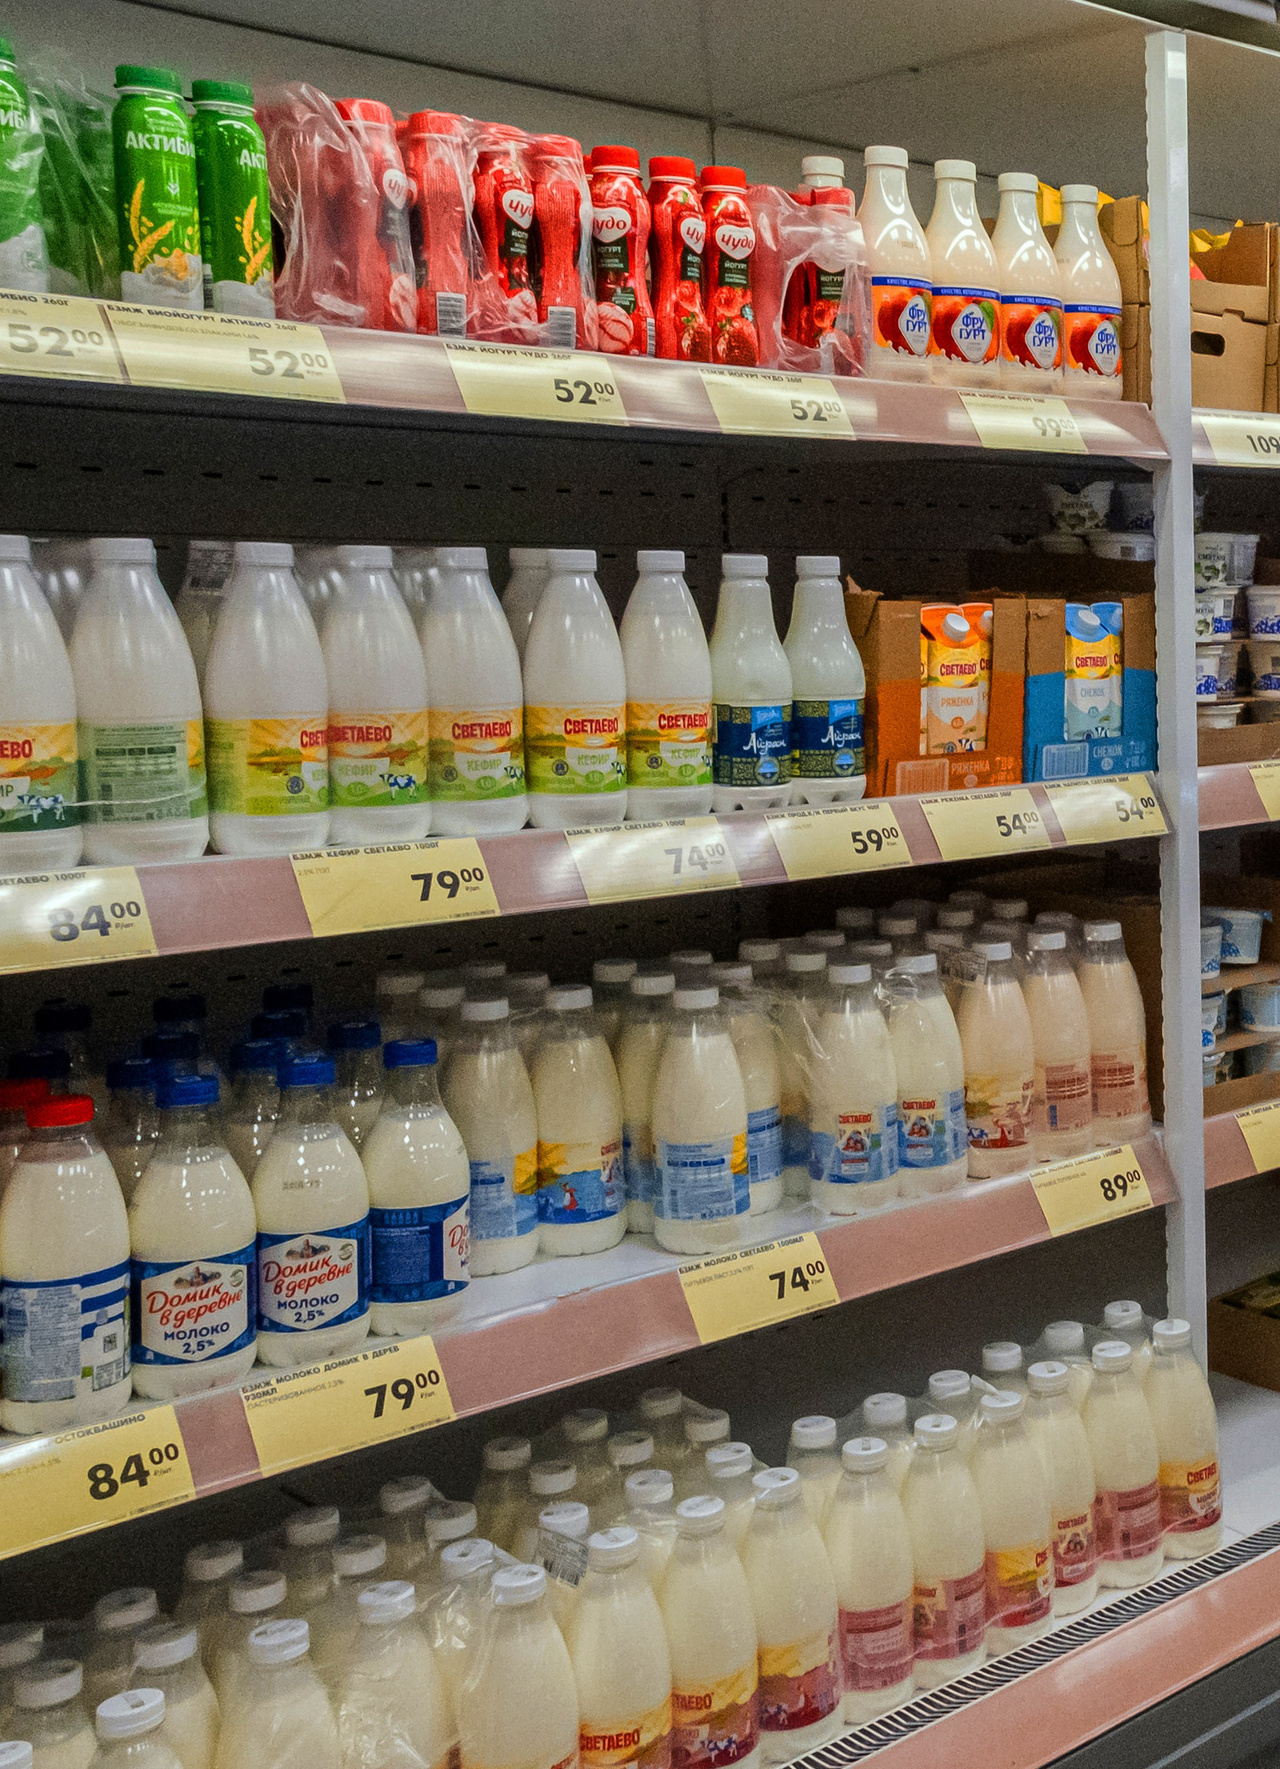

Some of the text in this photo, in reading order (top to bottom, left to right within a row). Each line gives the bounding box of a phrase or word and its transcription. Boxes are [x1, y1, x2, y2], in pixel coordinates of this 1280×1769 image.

[107, 303, 144, 316] БЗМЖ
[148, 308, 216, 324] БИОЙОГУРТ
[219, 315, 273, 330] АКТИБИО
[479, 346, 518, 358] ЙОГУРТ
[522, 351, 549, 360] ЧУДО
[940, 663, 977, 677] СВЕТАЕВО
[1075, 655, 1108, 669] СВЕТАЕВО
[452, 720, 512, 741] СВЕТАЕВО
[564, 716, 618, 736] СВЕТАЕВО
[658, 712, 708, 731] СВЕТАЕВО
[624, 820, 664, 832] СВЕТАЕВО
[292, 851, 324, 863] БЗМЖ
[327, 847, 361, 860] КЕФИР
[363, 843, 412, 857] СВЕТАЕВО
[678, 1263, 702, 1275] БЗМЖ
[704, 1253, 738, 1268] МОЛОКО
[739, 1243, 776, 1259] СВЕТАЕВО
[263, 1255, 333, 1284] Домик
[146, 1283, 224, 1314] Домик
[294, 1309, 325, 1325] 2,5%
[182, 1338, 216, 1356] 2,5%
[241, 1345, 401, 1394] БЗМЖ МОЛОКО ДОМИК В ДЕРЕВ
[244, 1387, 278, 1402] 930МЛ
